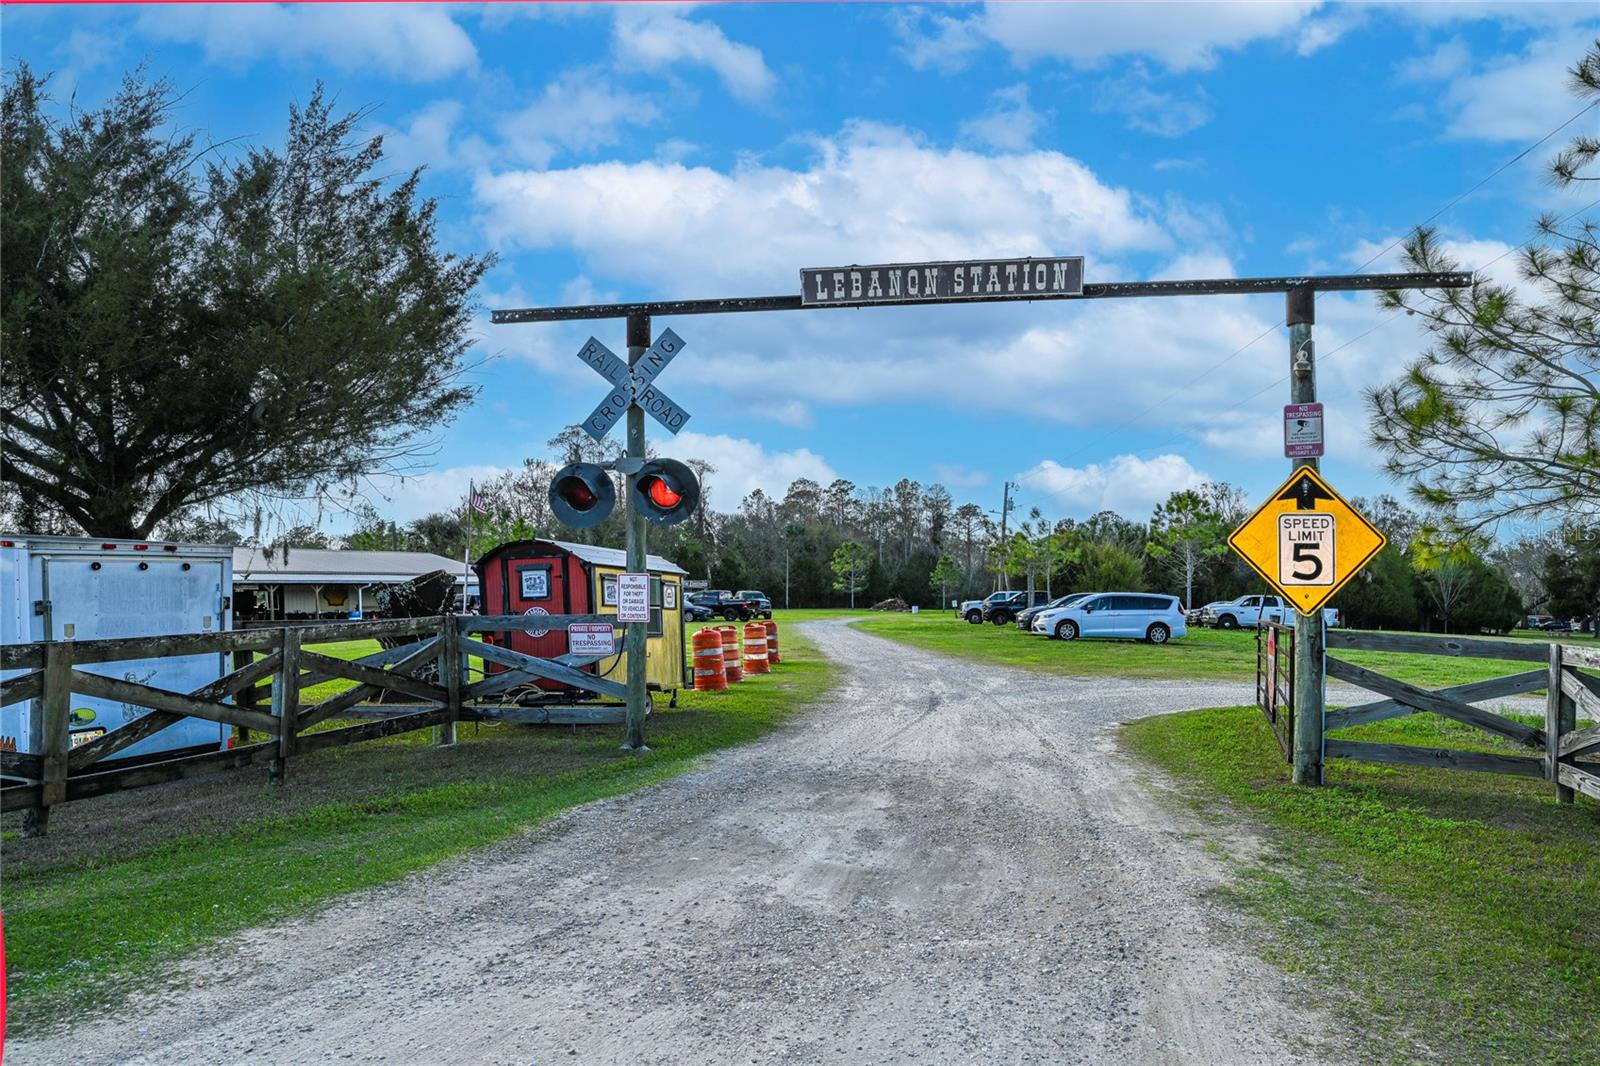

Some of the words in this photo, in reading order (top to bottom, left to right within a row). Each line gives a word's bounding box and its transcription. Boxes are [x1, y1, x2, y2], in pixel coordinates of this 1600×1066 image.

[815, 268, 939, 300] LEBANON
[953, 262, 1068, 294] STATION
[582, 343, 619, 381] RAIL
[591, 338, 675, 431] CROSSING
[640, 389, 684, 428] ROAD
[1286, 410, 1322, 418] TRESPASSING
[1283, 518, 1330, 529] SPEED
[1288, 530, 1325, 541] LIMIT
[1291, 543, 1323, 580] 5
